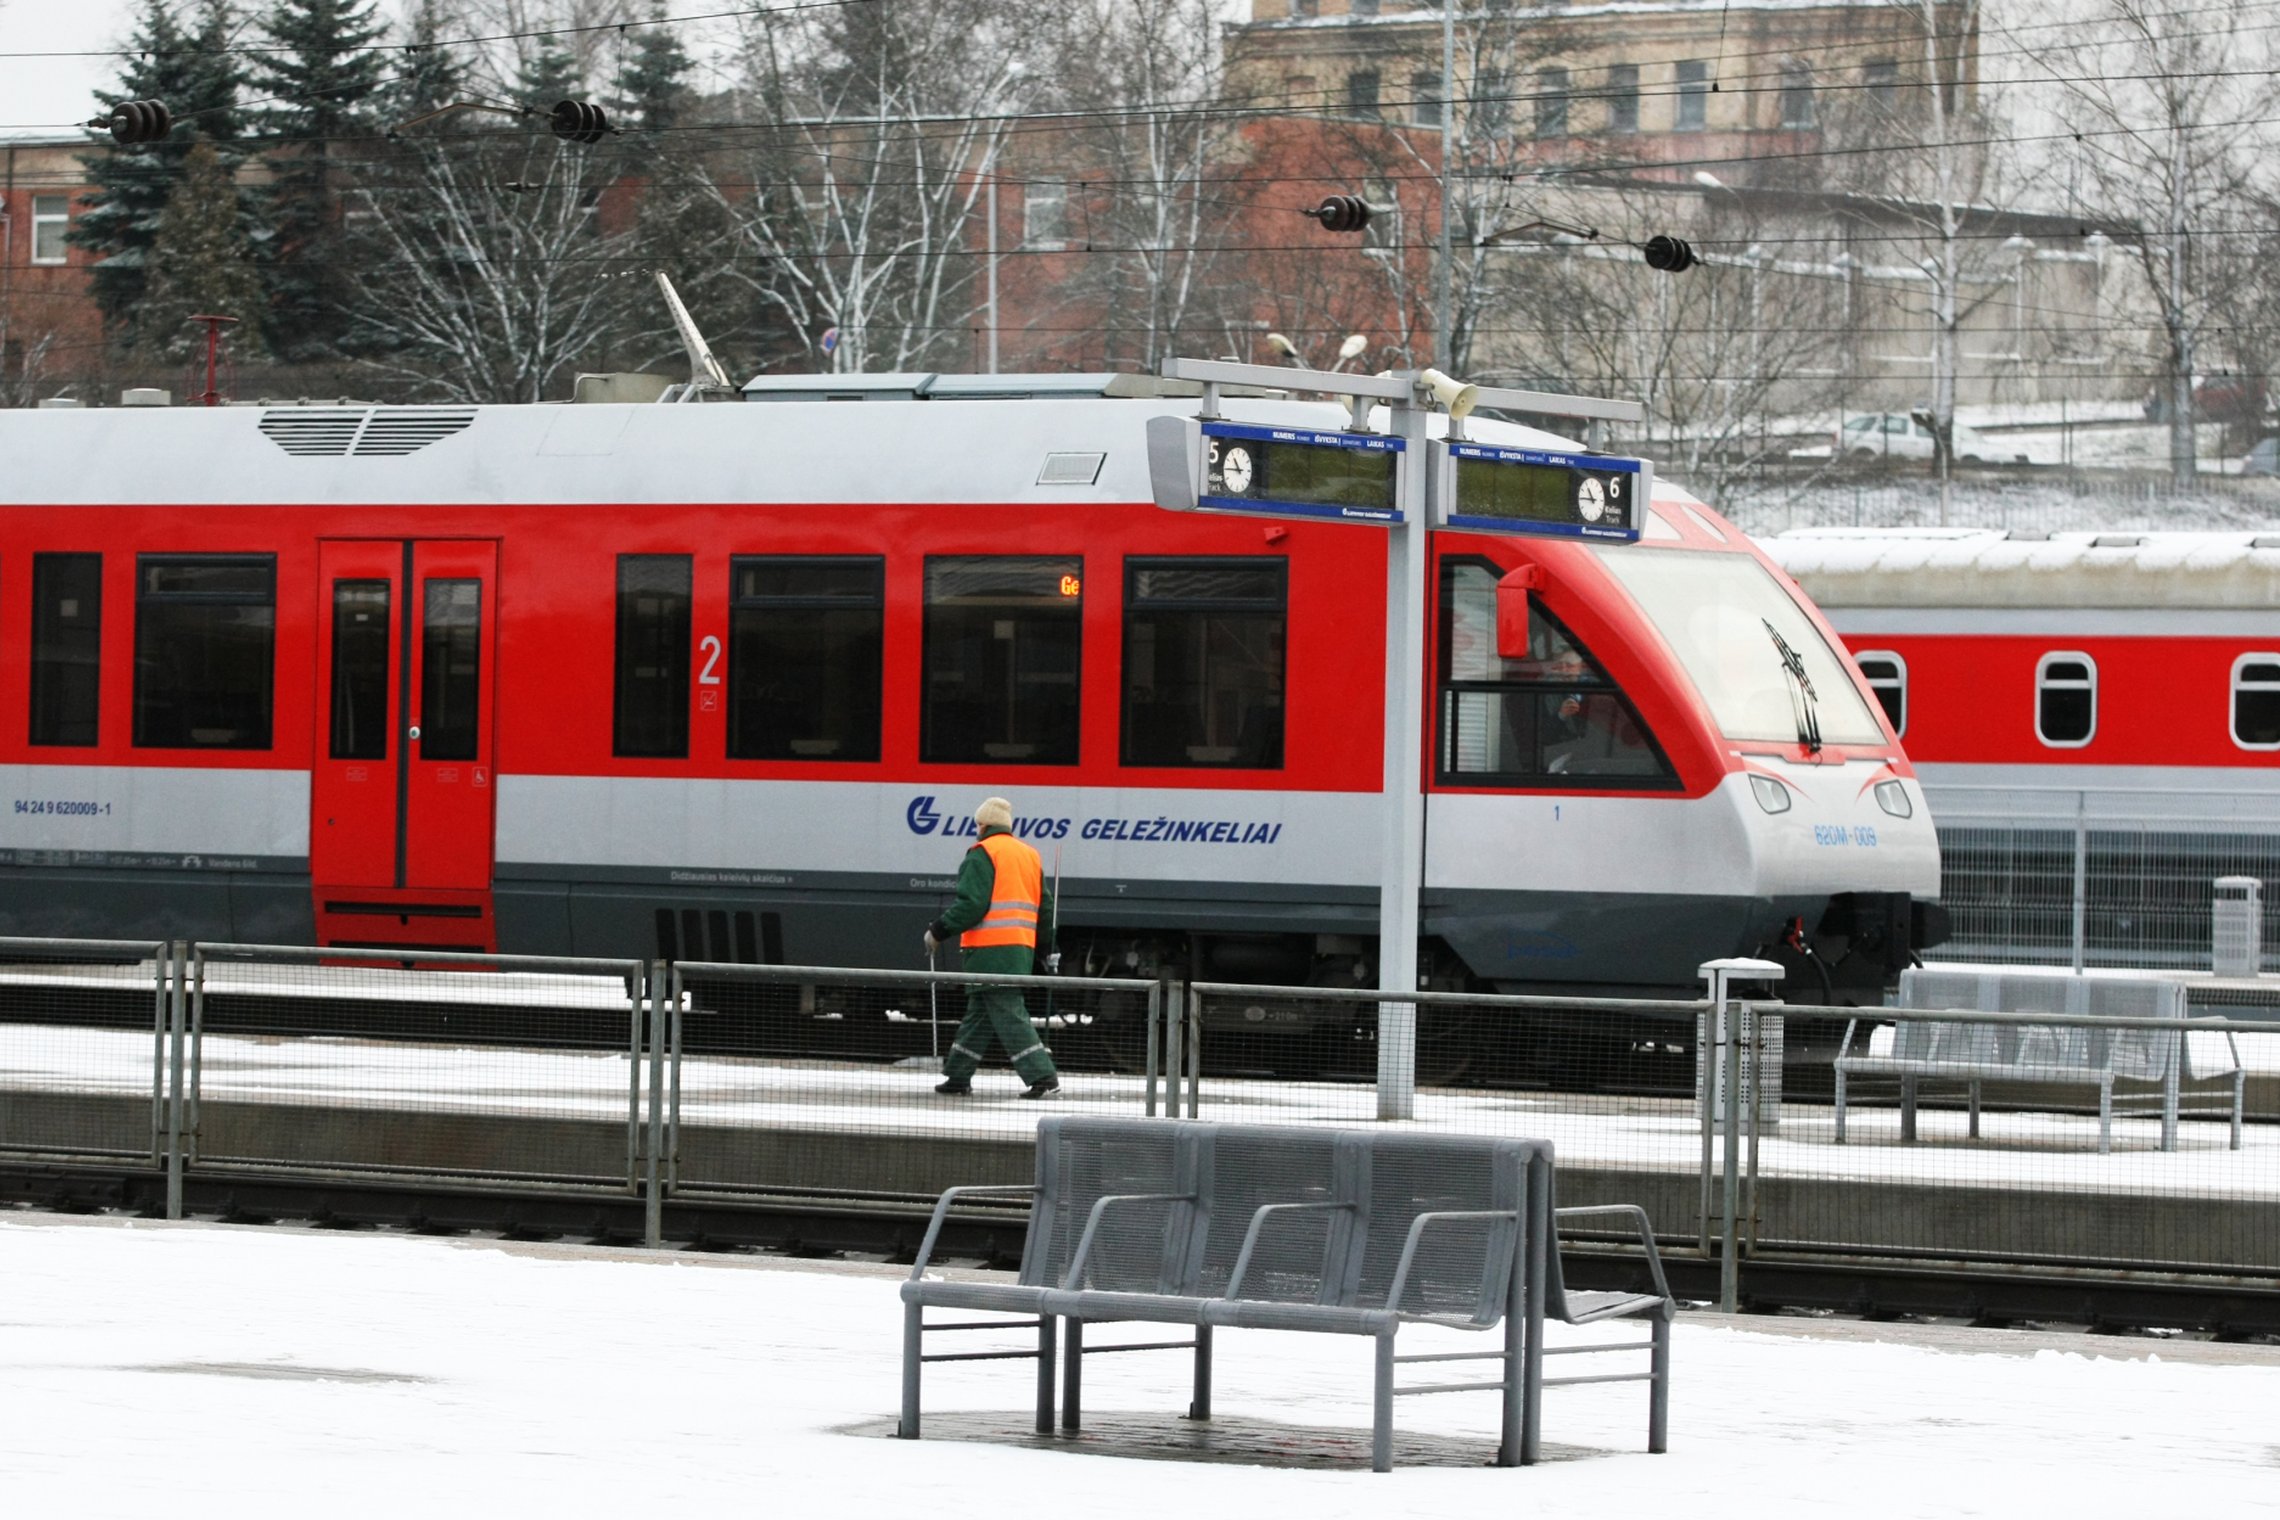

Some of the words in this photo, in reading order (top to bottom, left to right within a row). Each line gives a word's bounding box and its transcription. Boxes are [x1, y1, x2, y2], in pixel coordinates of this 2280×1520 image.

[1209, 441, 1219, 464] 5
[1609, 476, 1620, 499] 6
[699, 635, 721, 685] 2
[15, 800, 28, 814] 94
[30, 801, 45, 814] 24
[47, 801, 54, 814] 9
[1081, 816, 1282, 844] GELEŽINKELIAI
